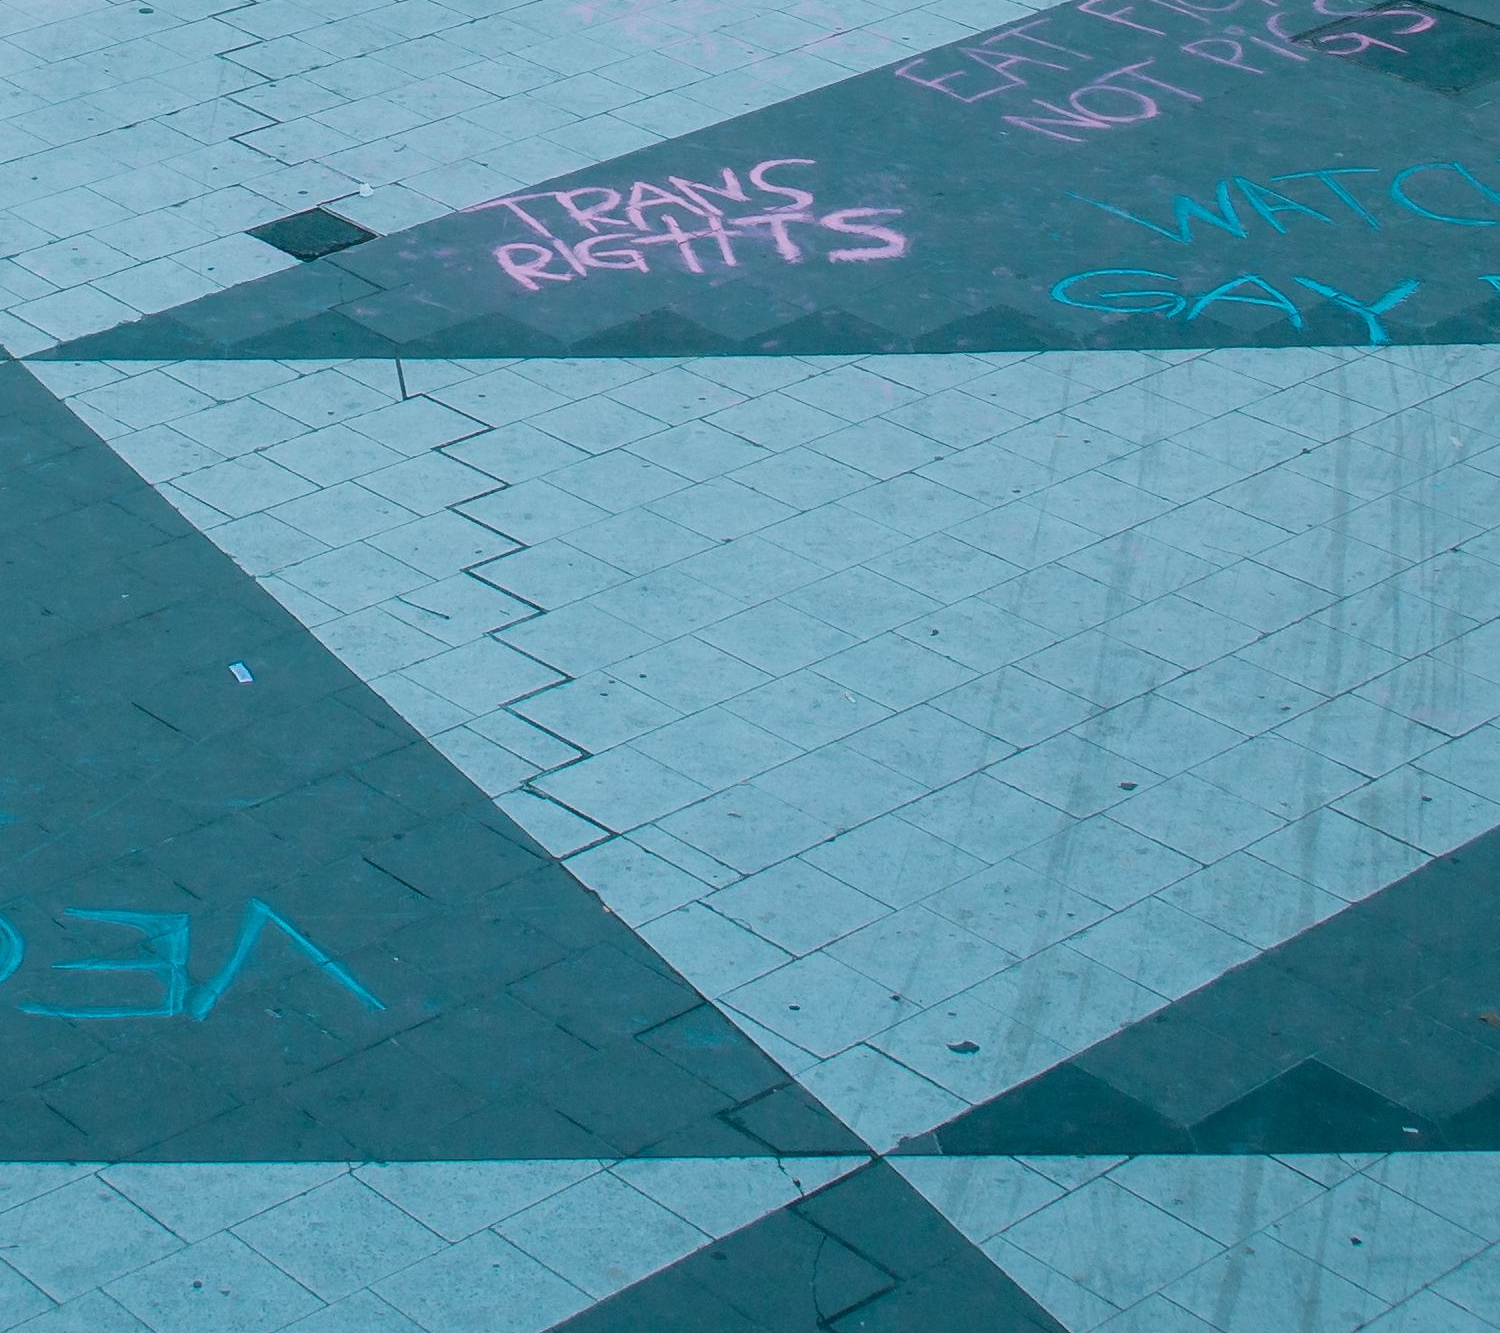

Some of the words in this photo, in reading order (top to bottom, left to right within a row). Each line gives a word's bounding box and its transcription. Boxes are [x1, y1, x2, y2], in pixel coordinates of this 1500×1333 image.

[894, 16, 1094, 105] EAT
[1002, 57, 1202, 143] NOT
[455, 157, 818, 240] TRANS
[496, 204, 912, 292] RIGHTS
[1050, 266, 1420, 347] GAY
